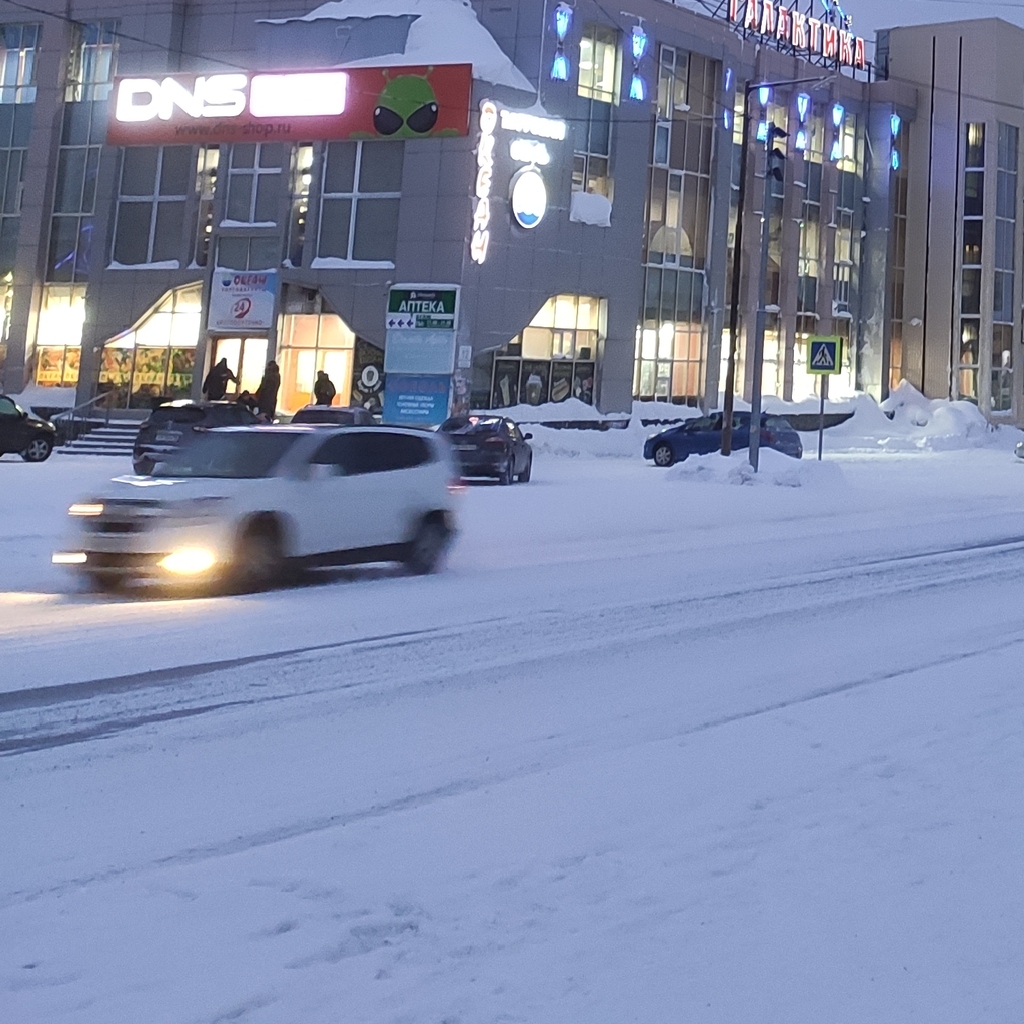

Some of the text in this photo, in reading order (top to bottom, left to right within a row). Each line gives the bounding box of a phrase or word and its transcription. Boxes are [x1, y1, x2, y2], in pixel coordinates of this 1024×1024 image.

[115, 73, 248, 122] DNS
[175, 121, 291, 137] www.dnsshop.ru
[398, 300, 445, 313] АПТЕКА
